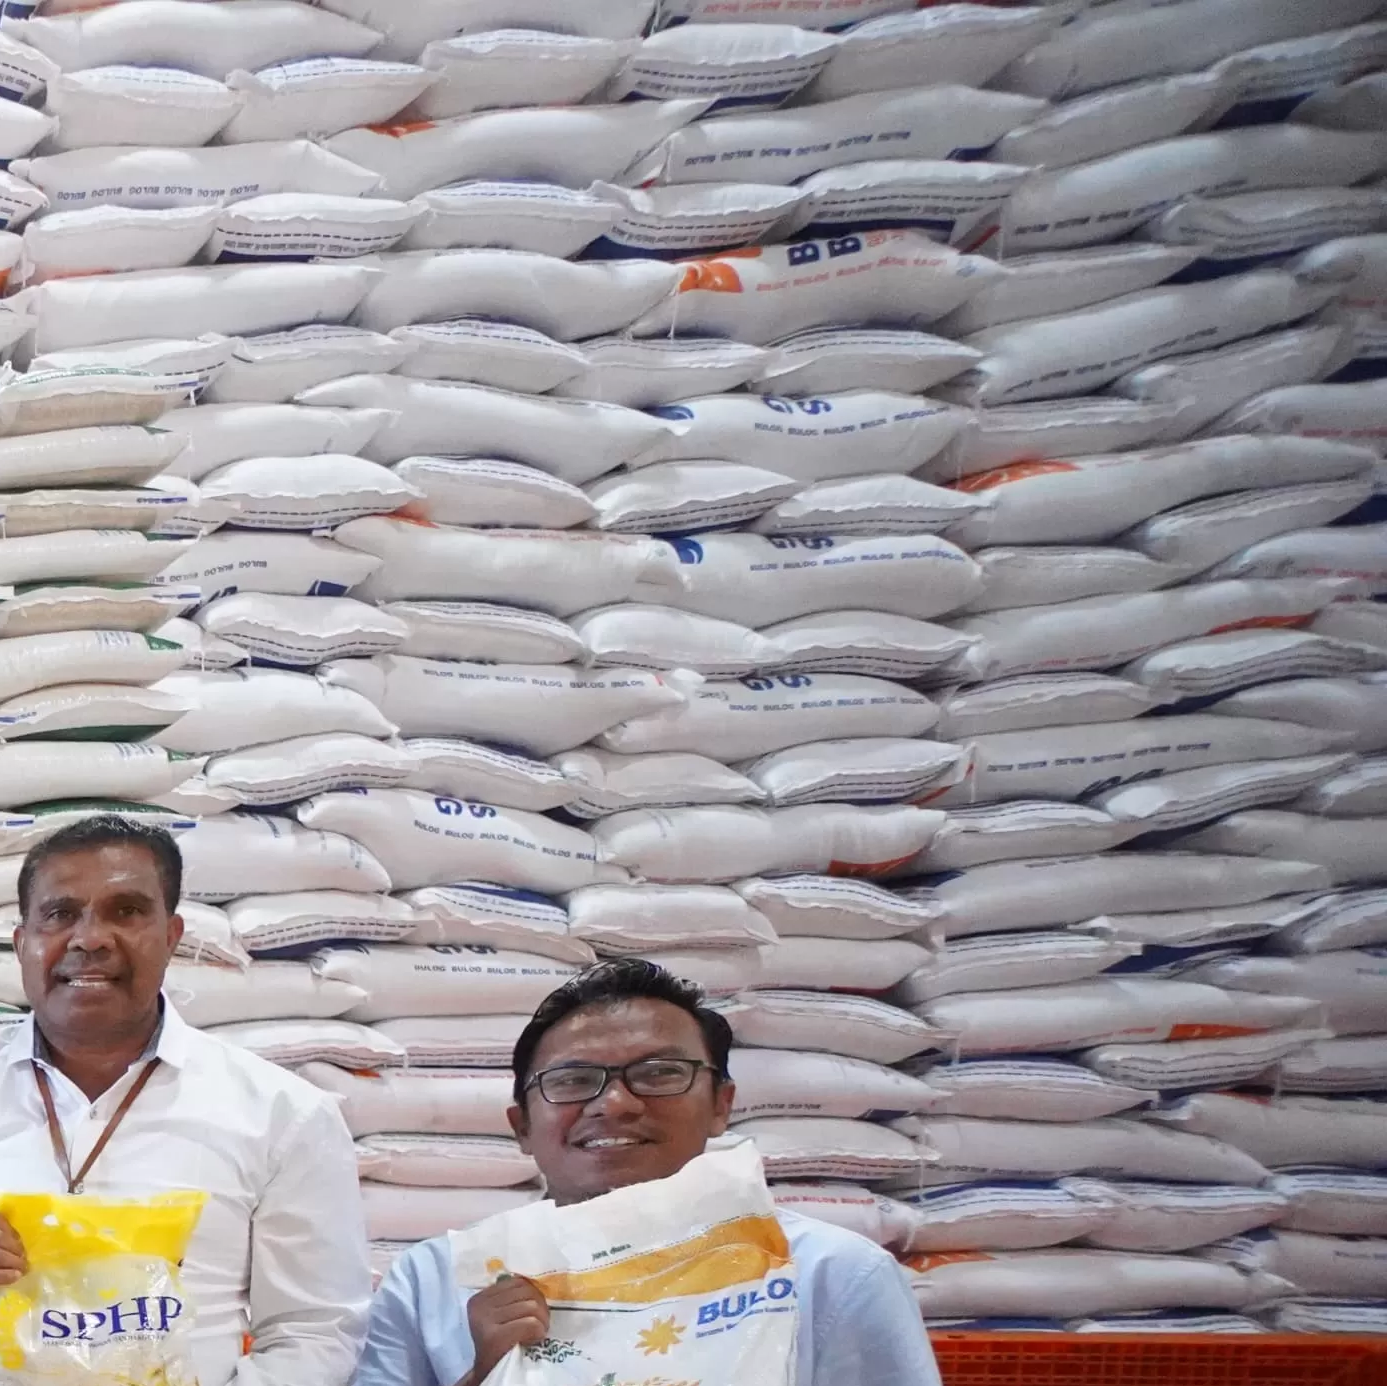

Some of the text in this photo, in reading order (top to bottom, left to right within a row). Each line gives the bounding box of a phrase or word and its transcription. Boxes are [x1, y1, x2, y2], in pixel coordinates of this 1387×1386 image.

[480, 832, 509, 841] BULOG
[542, 847, 570, 858] BULOG
[42, 1296, 182, 1340] SPHP
[697, 1278, 796, 1325] BULO
